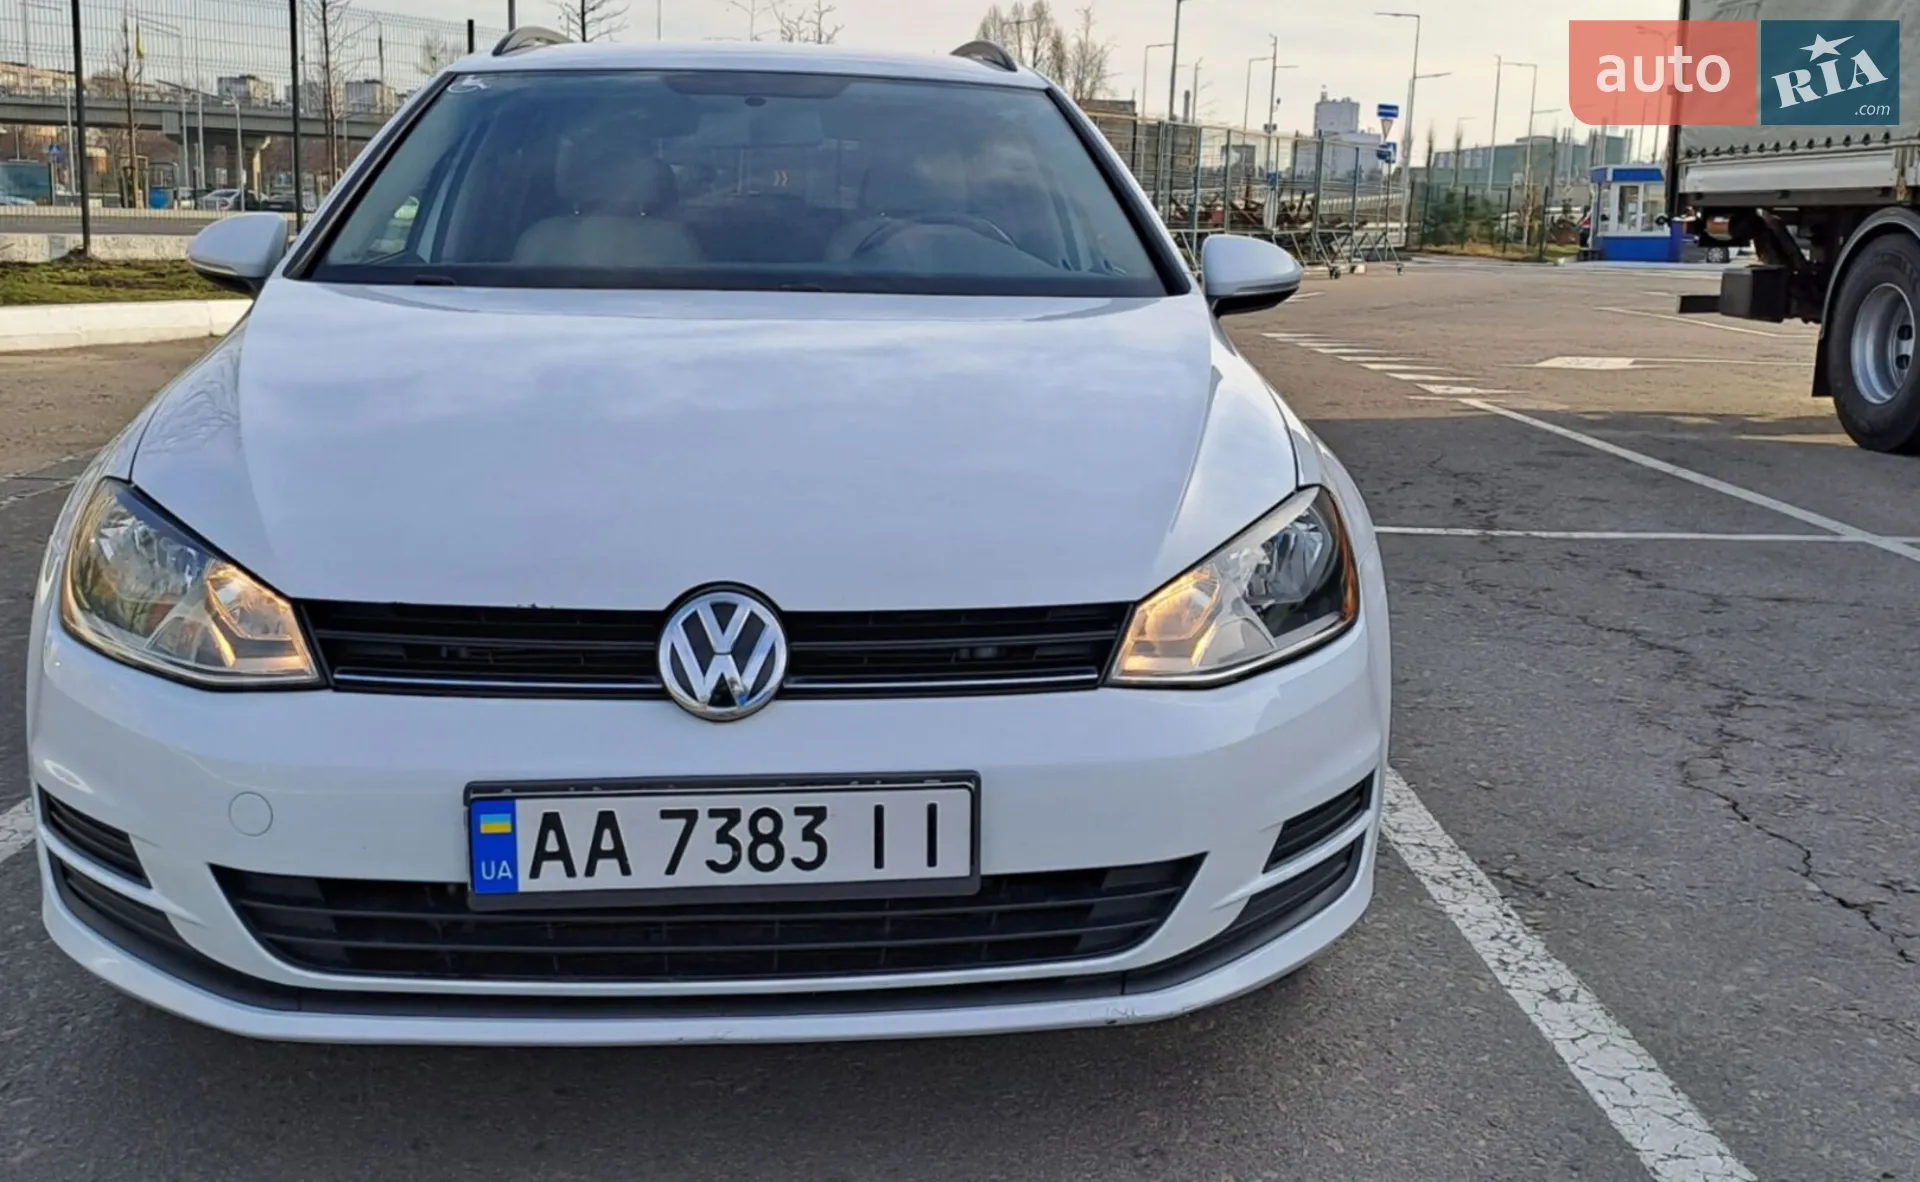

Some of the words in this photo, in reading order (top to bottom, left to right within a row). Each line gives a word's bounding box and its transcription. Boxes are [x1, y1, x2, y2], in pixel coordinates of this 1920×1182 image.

[528, 809, 633, 881] AA
[658, 805, 829, 877] 7383
[480, 860, 513, 882] UA
